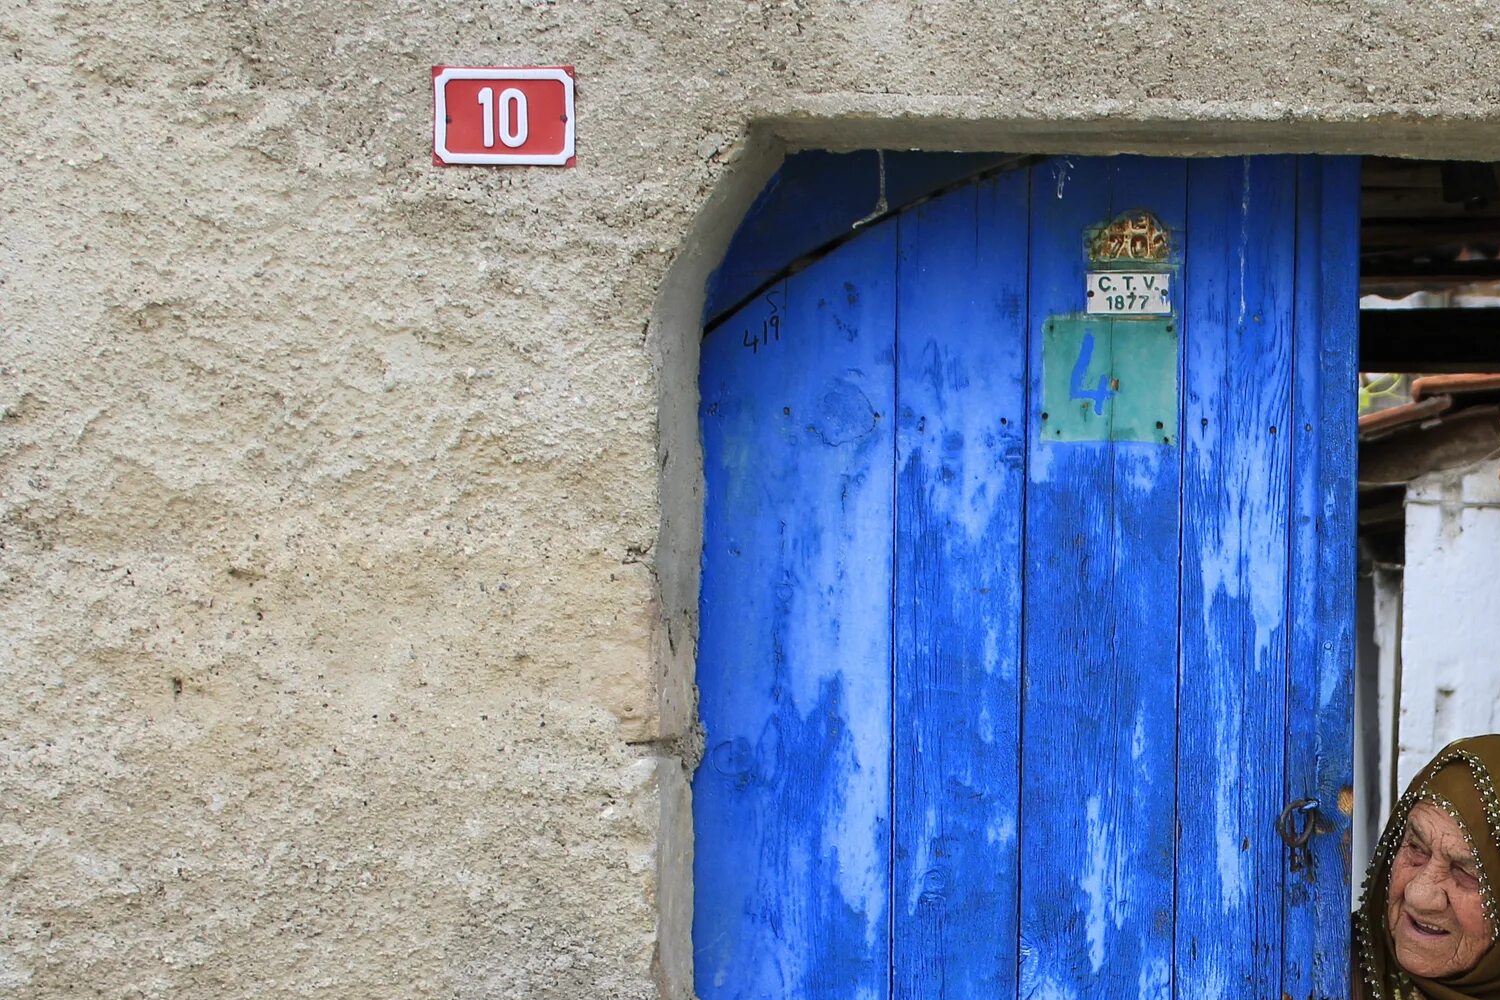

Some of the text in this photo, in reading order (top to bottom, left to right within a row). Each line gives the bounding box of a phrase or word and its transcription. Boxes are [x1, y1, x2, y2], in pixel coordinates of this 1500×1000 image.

[477, 87, 529, 148] 10
[1098, 276, 1160, 292] C. T. V.
[1106, 295, 1150, 310] 1877
[743, 315, 780, 354] 419
[1069, 330, 1115, 416] 4
